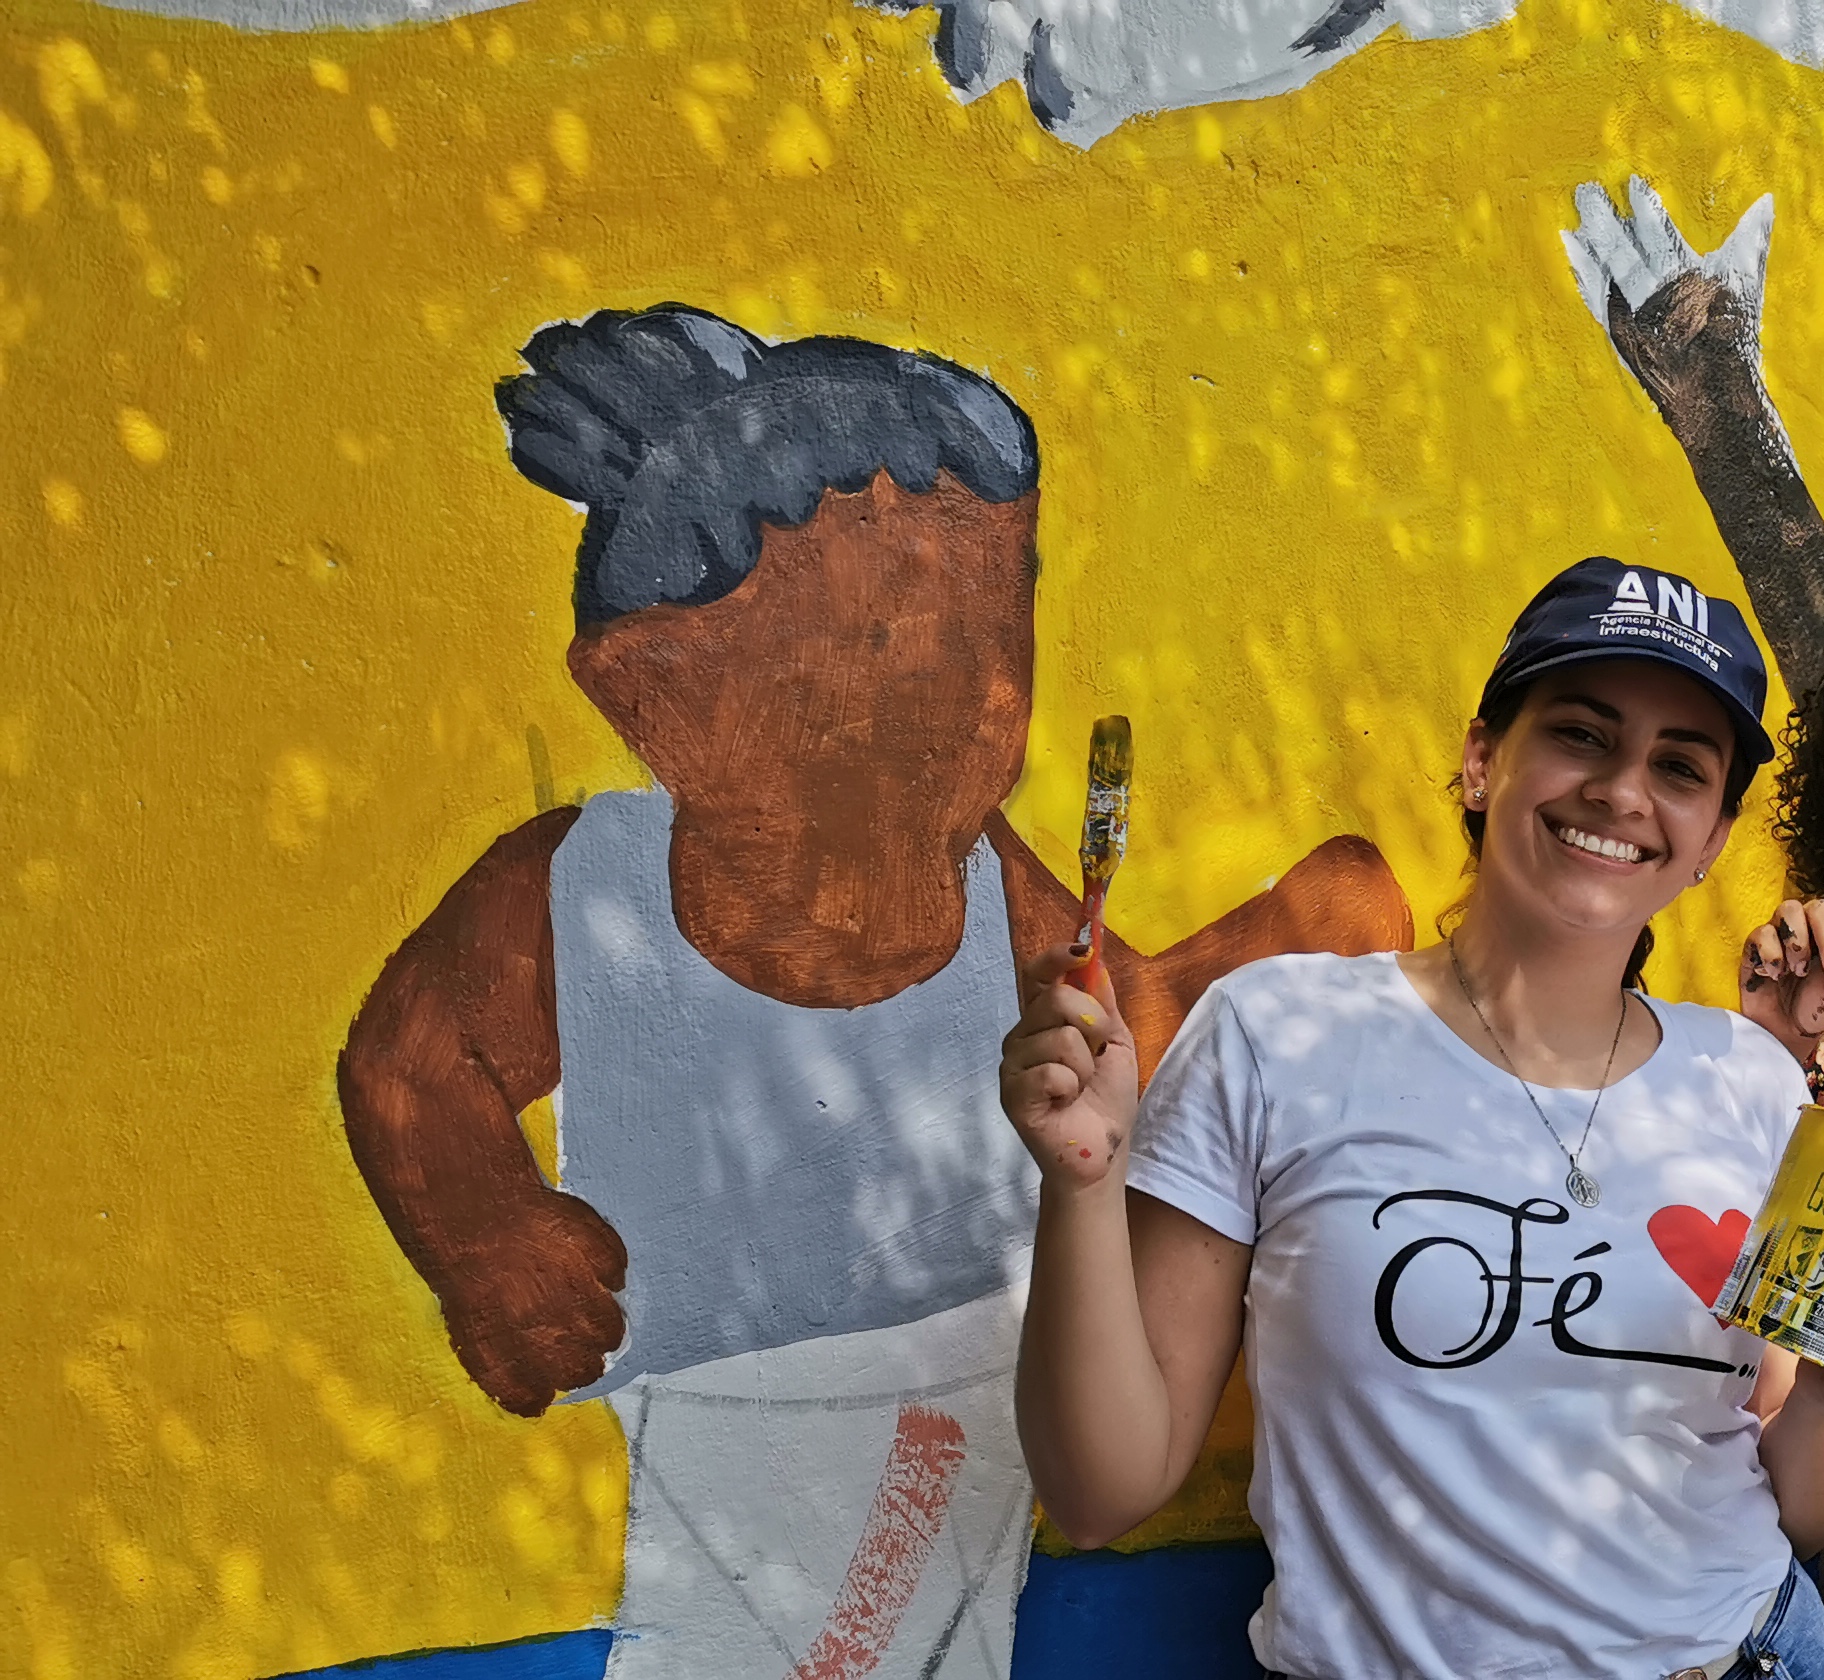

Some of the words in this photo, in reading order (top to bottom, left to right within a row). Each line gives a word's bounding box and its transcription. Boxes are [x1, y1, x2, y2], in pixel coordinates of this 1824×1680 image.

[1607, 570, 1709, 636] ANI
[1599, 625, 1719, 673] Infraestructura
[1600, 615, 1651, 627] Agencia
[1655, 619, 1705, 647] Nacional
[1707, 641, 1721, 657] de
